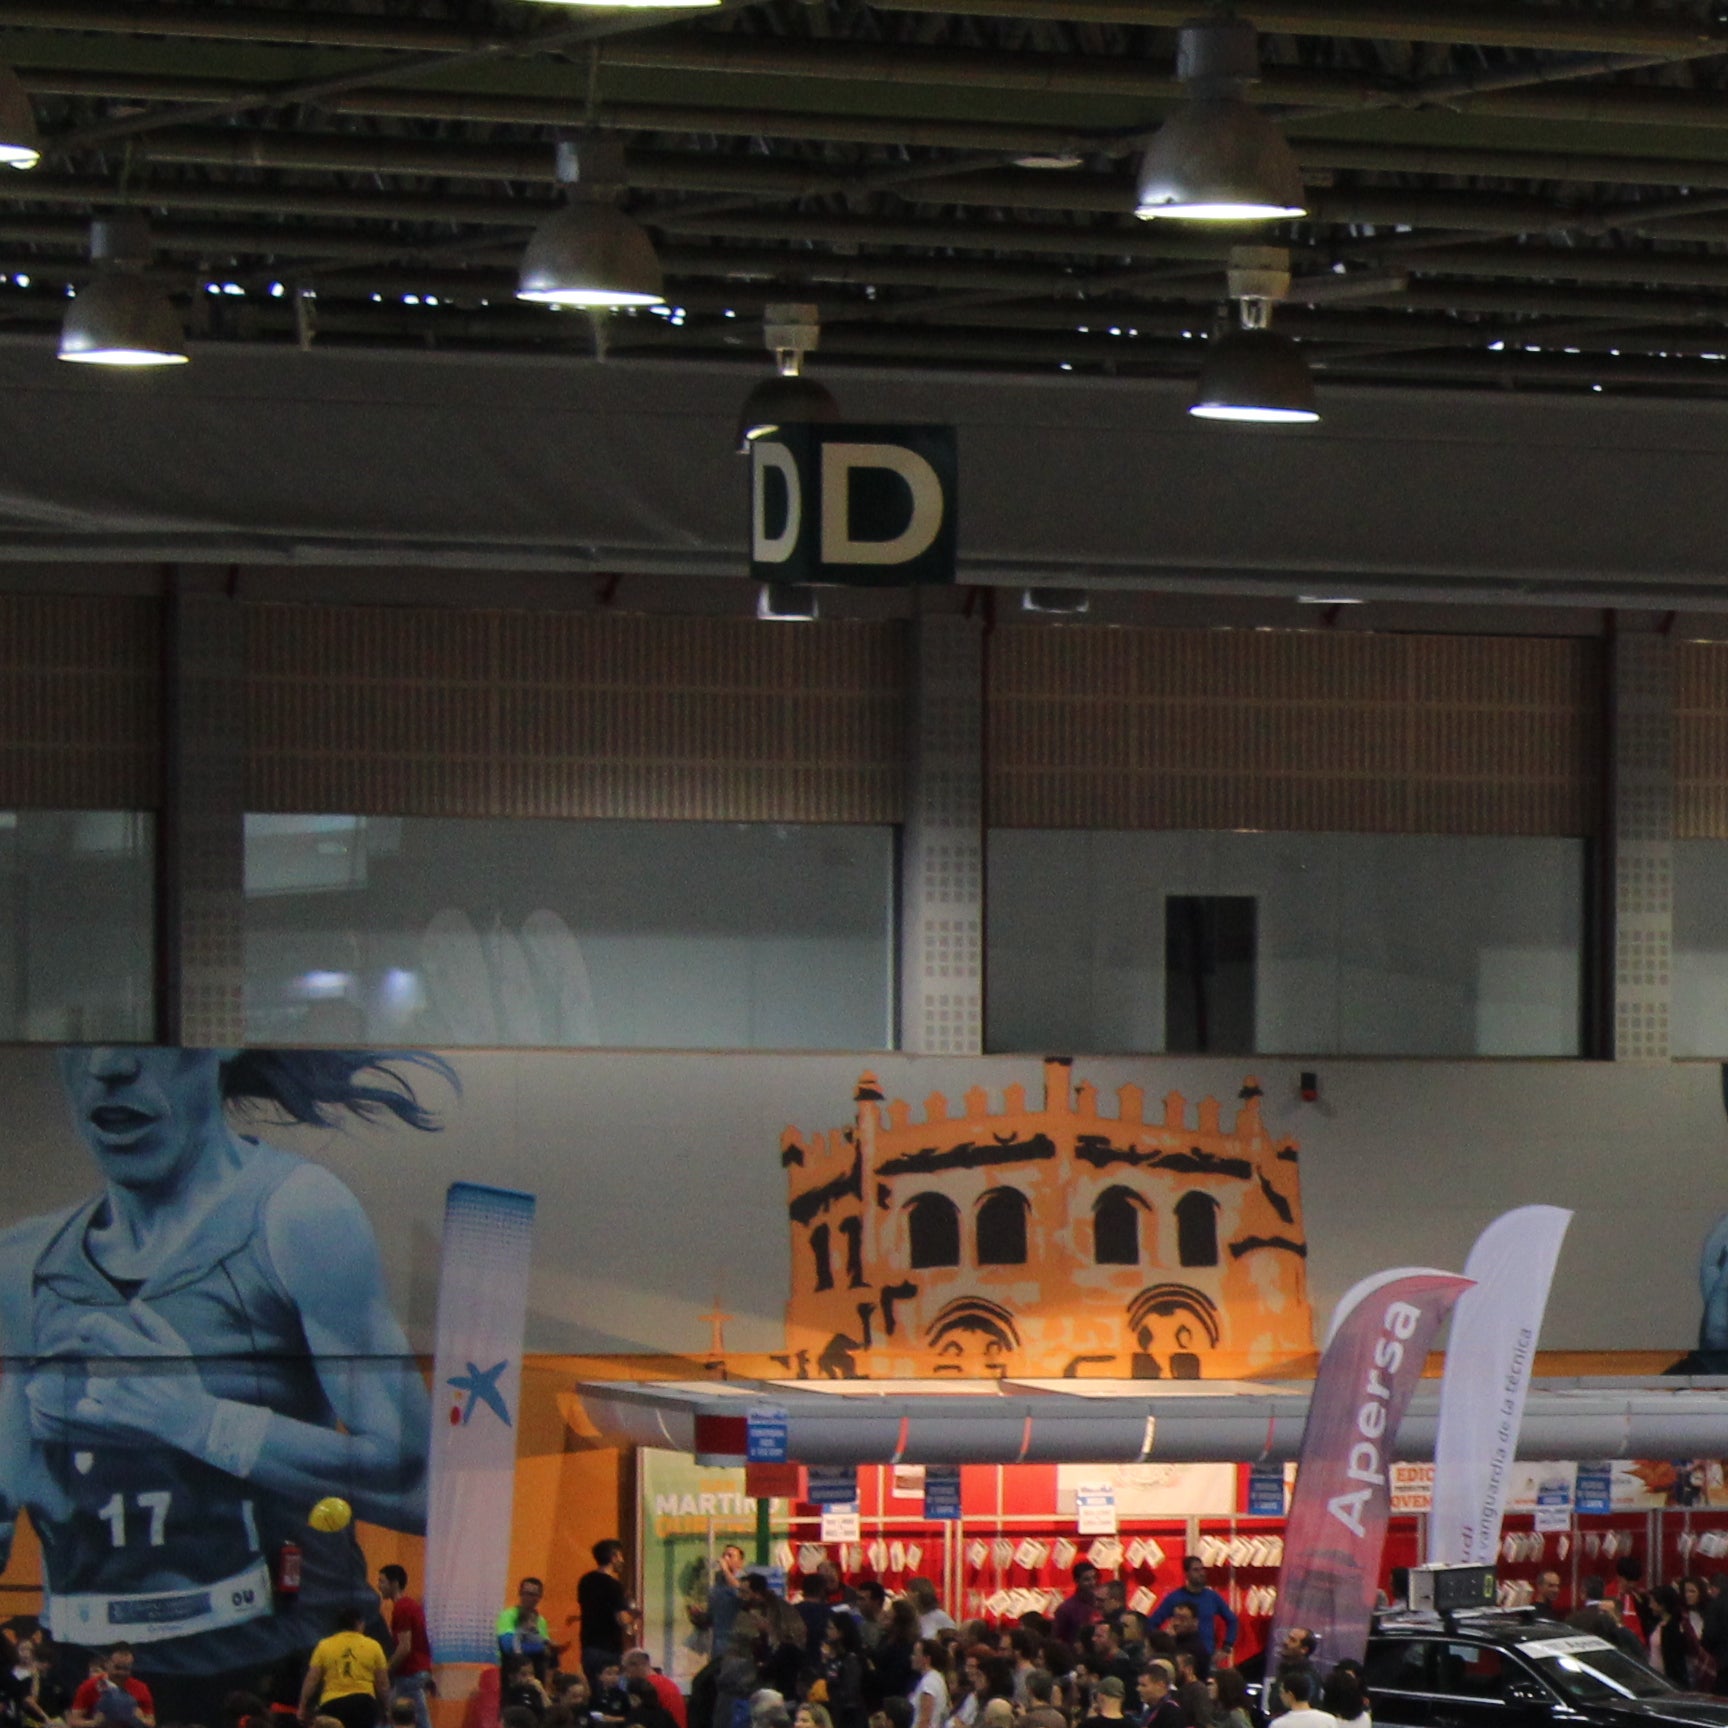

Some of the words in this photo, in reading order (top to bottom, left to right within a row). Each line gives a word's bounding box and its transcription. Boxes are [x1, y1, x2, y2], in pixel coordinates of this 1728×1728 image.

[753, 442, 801, 563] D
[821, 442, 944, 565] D
[1505, 1328, 1533, 1394] técnica
[1327, 1302, 1422, 1538] Apersa
[1498, 1419, 1512, 1442] de
[1501, 1398, 1514, 1416] la
[98, 1491, 171, 1547] 17
[1479, 1446, 1507, 1551] vanguardia
[1461, 1525, 1474, 1564] udi
